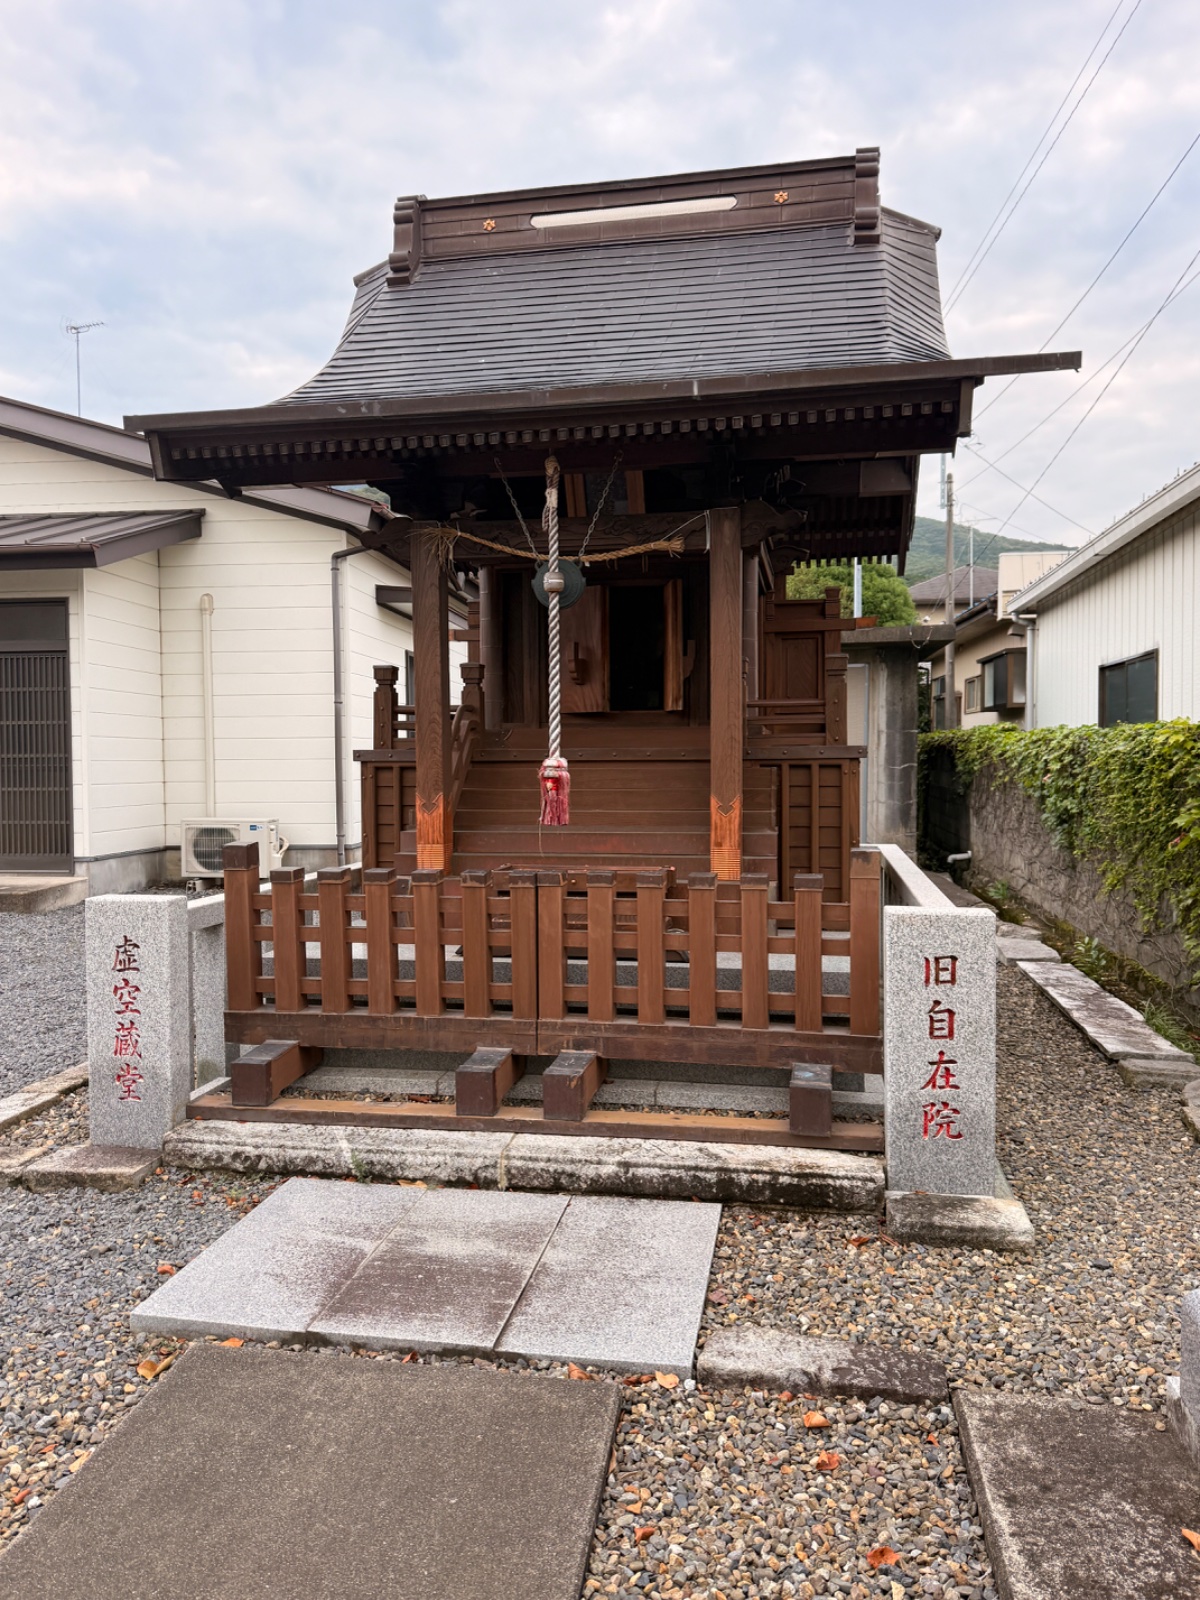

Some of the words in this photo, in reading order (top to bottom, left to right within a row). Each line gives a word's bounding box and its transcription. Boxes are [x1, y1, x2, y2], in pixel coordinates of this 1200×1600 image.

[112, 935, 142, 1101] 虚空蔵堂
[921, 954, 964, 1140] 旧自在院
